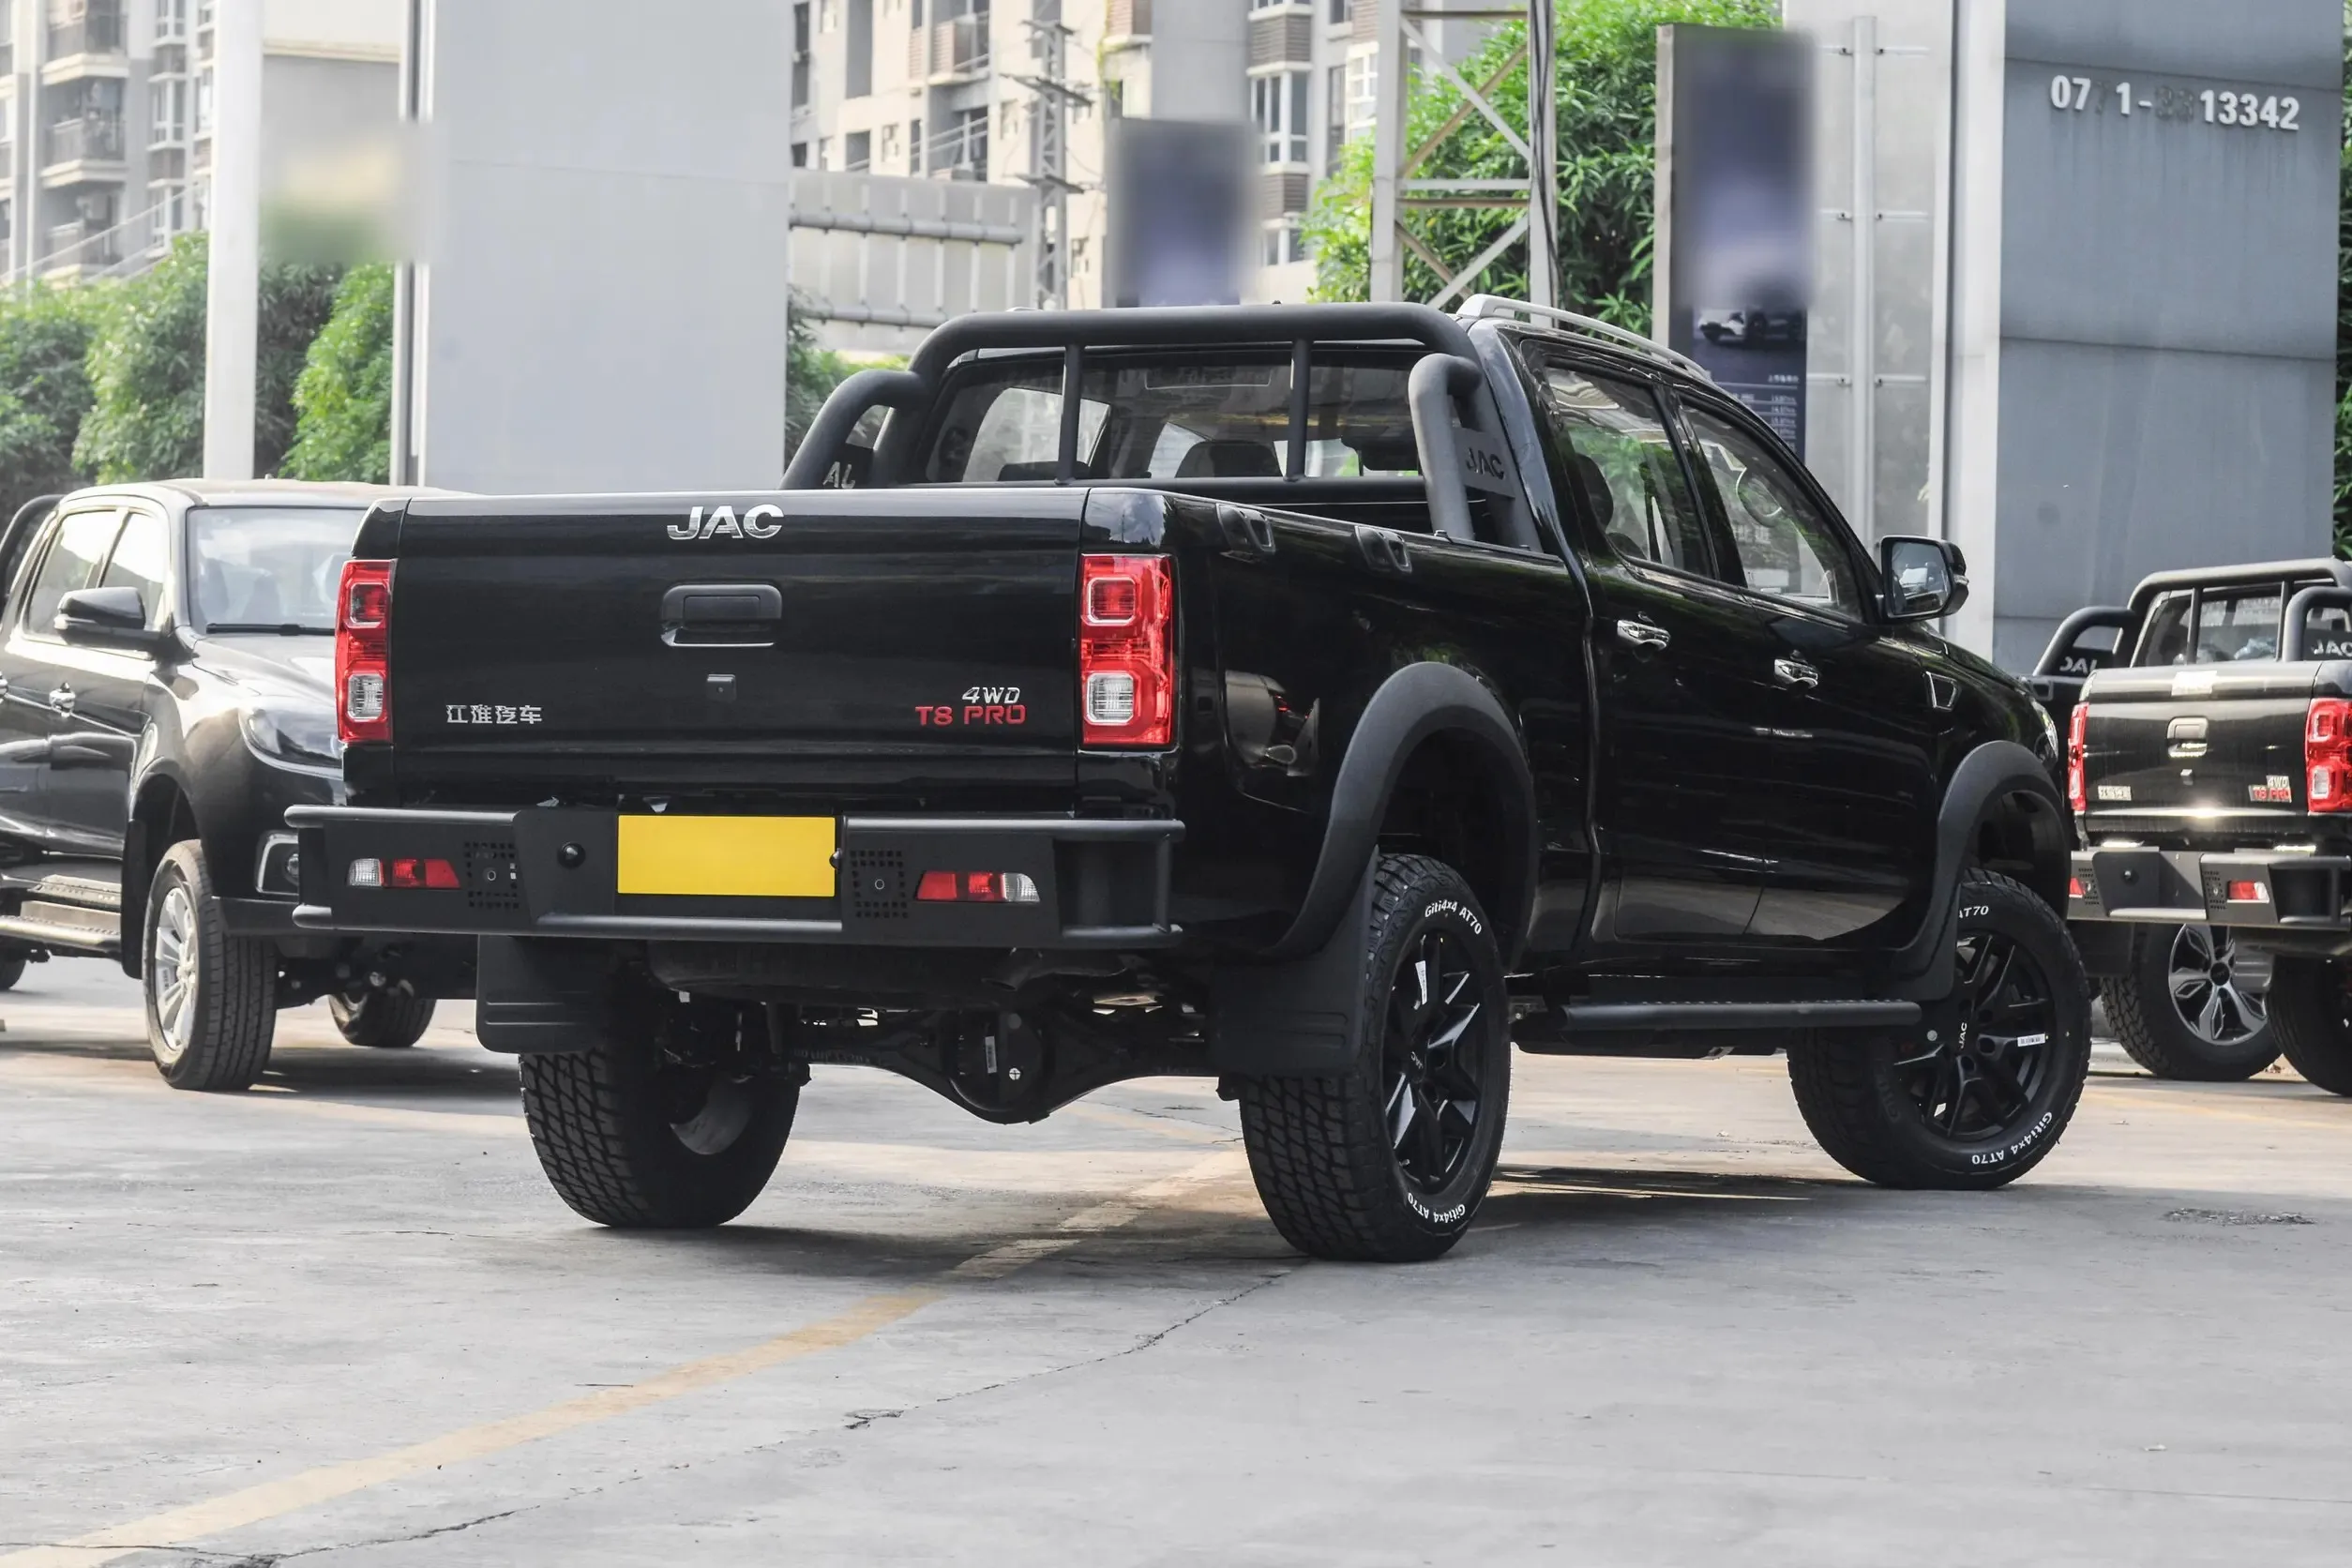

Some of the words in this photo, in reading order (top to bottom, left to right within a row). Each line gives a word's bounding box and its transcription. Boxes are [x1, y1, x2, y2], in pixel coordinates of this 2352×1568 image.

[1465, 447, 1505, 480] JAC
[667, 504, 785, 540] JAC
[961, 686, 1020, 703] 4WD
[445, 704, 542, 724] 江淮汽车
[914, 706, 953, 726] T8
[963, 704, 1027, 725] PRO
[1425, 899, 1458, 918] Giti4x4
[1459, 907, 1482, 935] AT70
[2011, 1111, 2053, 1155] Giti4x4
[1971, 1149, 2005, 1165] AT70
[1407, 1192, 1430, 1219] AT70
[1433, 1203, 1466, 1224] Giti4x4
